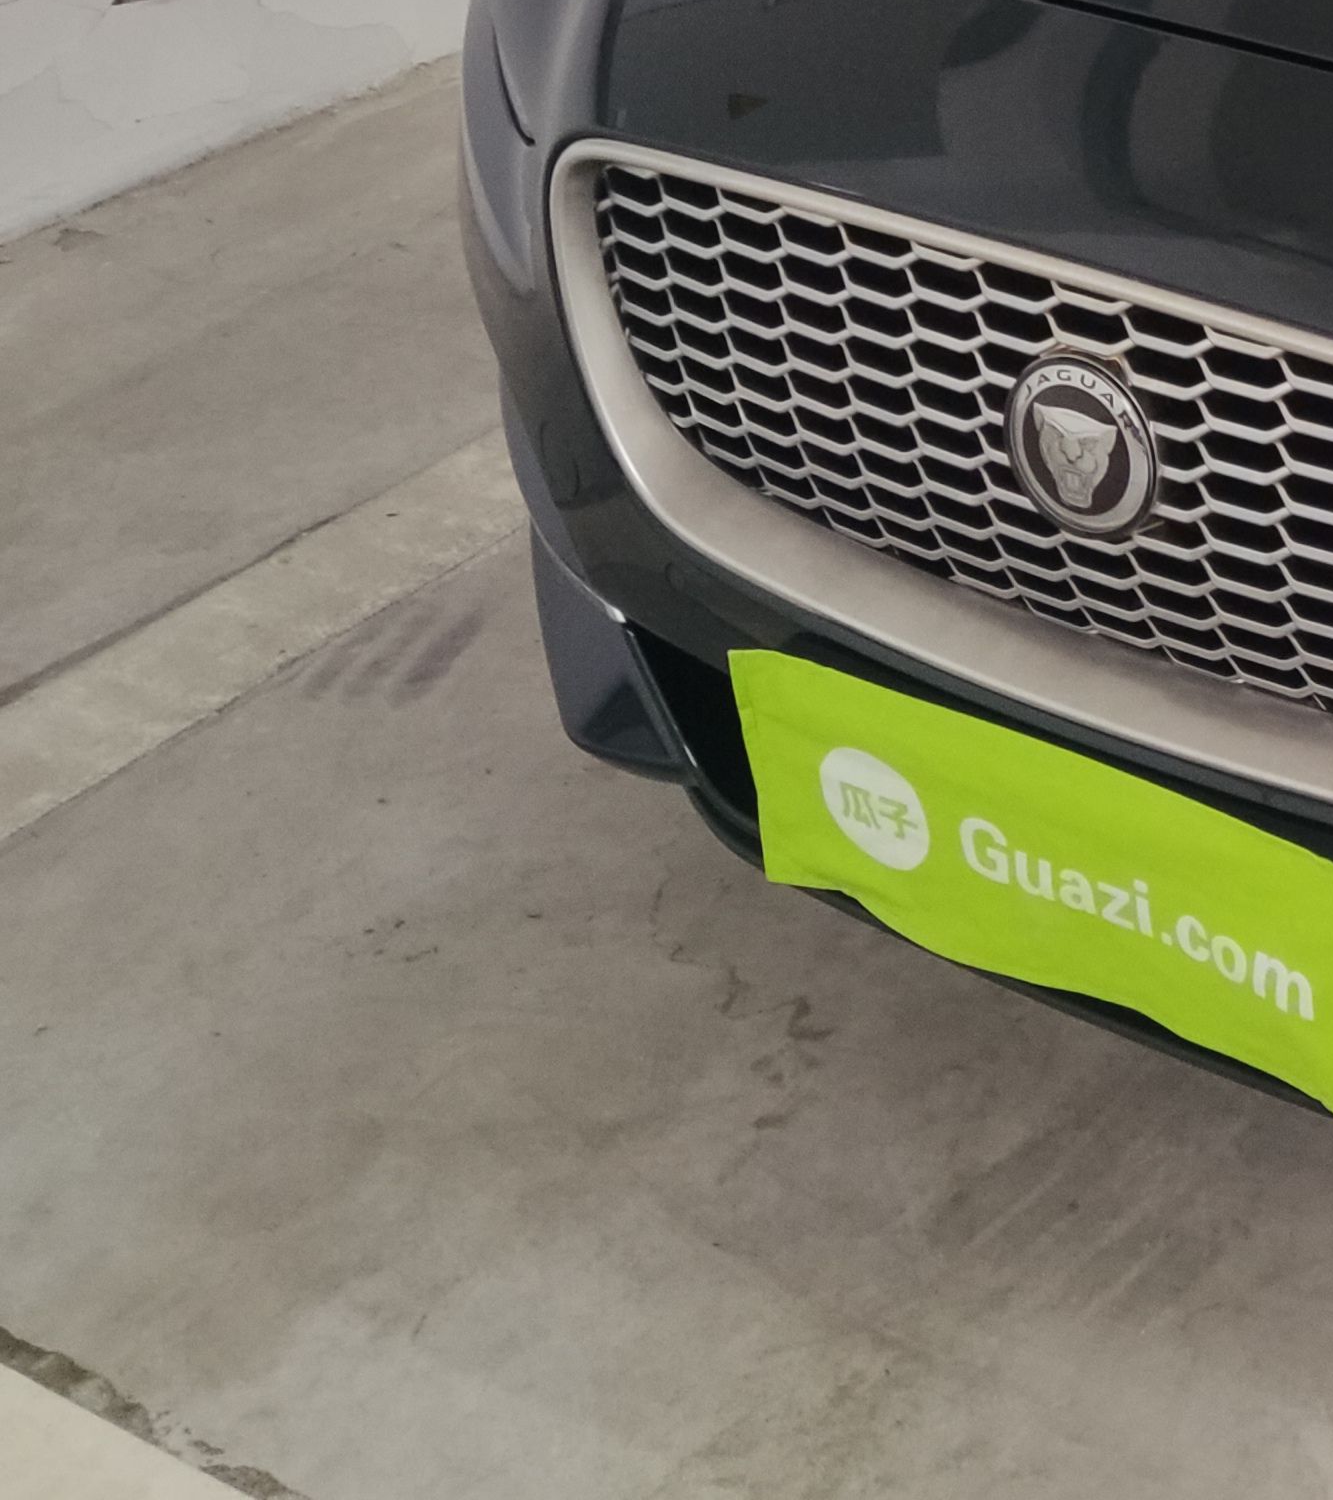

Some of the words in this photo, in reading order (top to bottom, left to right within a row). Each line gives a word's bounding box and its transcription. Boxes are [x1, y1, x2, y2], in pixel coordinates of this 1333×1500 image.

[1024, 369, 1136, 432] JAGUAR
[840, 781, 918, 841] 瓜子
[959, 816, 1315, 1021] Guazi.com
